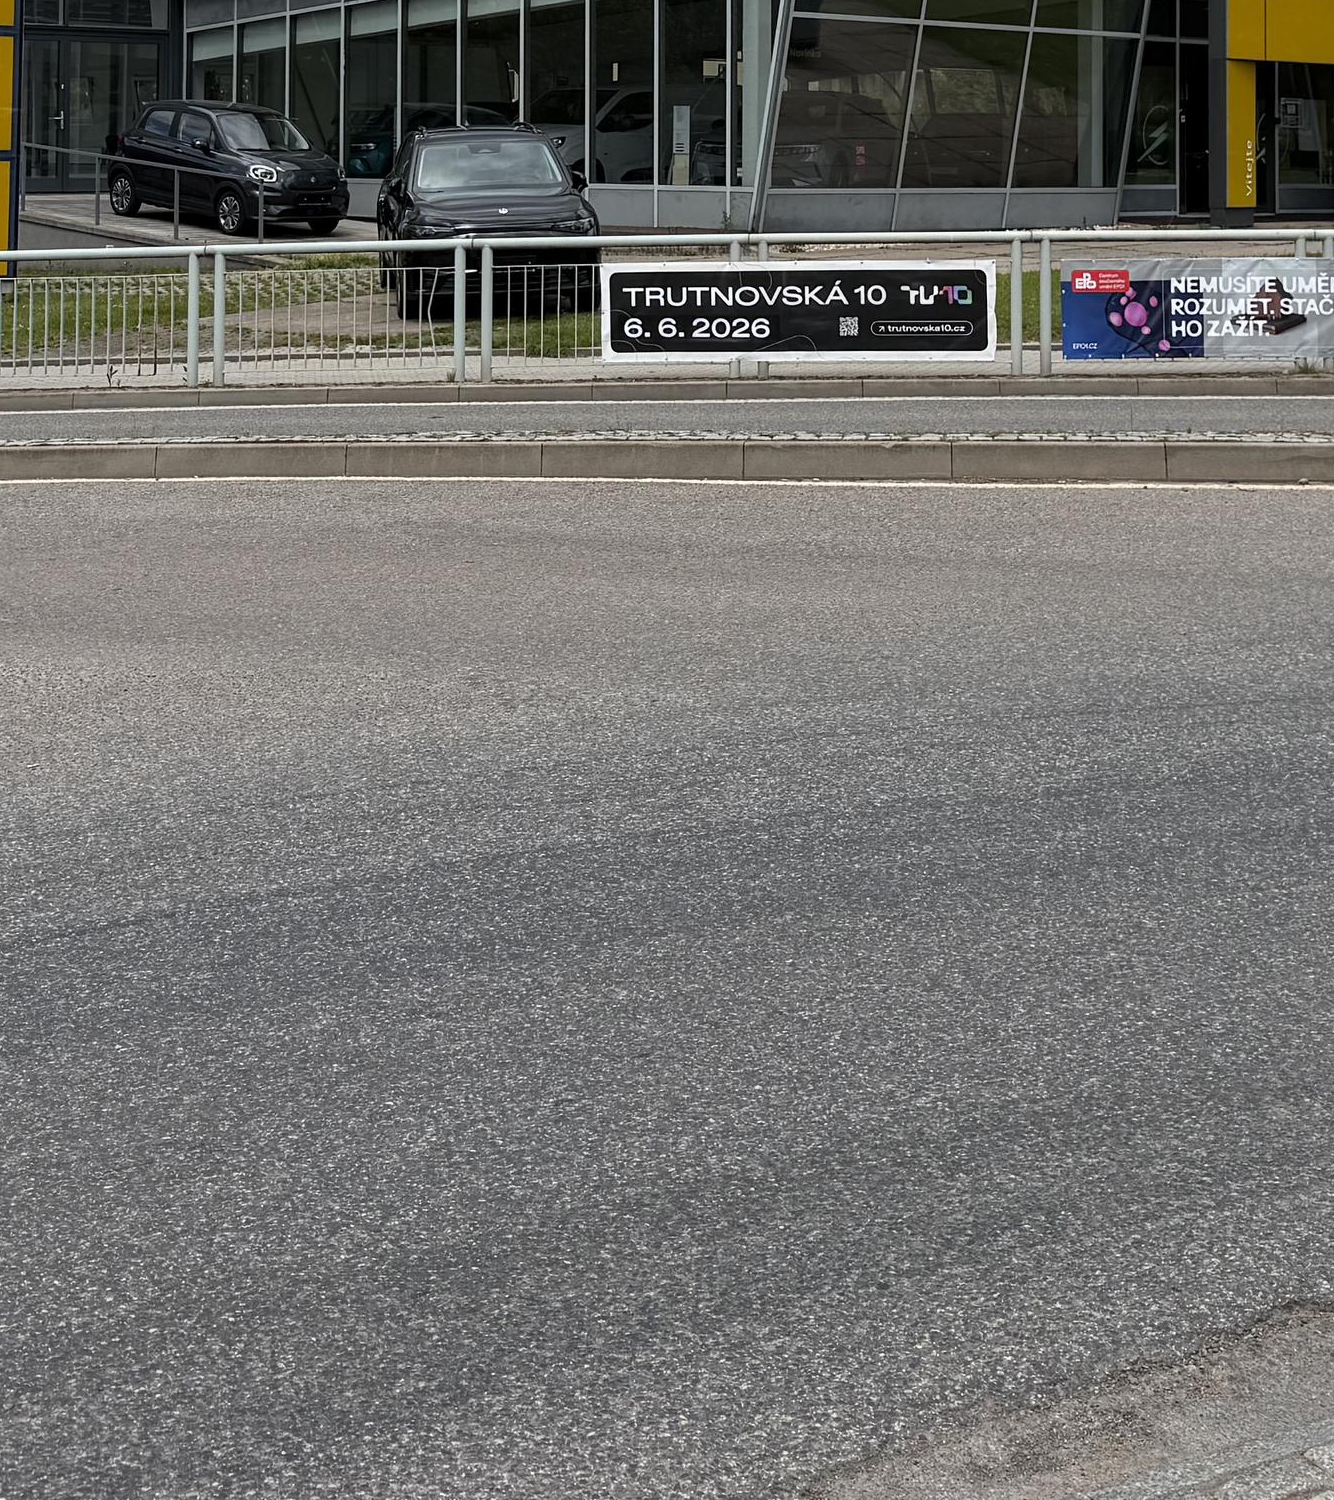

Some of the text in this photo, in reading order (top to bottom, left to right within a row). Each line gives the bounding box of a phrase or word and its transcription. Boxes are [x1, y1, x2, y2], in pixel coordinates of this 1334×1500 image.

[622, 280, 887, 307] TRUTNOVSKÁ 10
[1170, 273, 1277, 293] NEMUSÍTE
[1170, 294, 1275, 315] ROZUMĚT.
[623, 317, 771, 339] 6. 6. 2026
[887, 324, 966, 333] trutnovska10.cz
[1171, 316, 1271, 338] HO ZAŽÍT.
